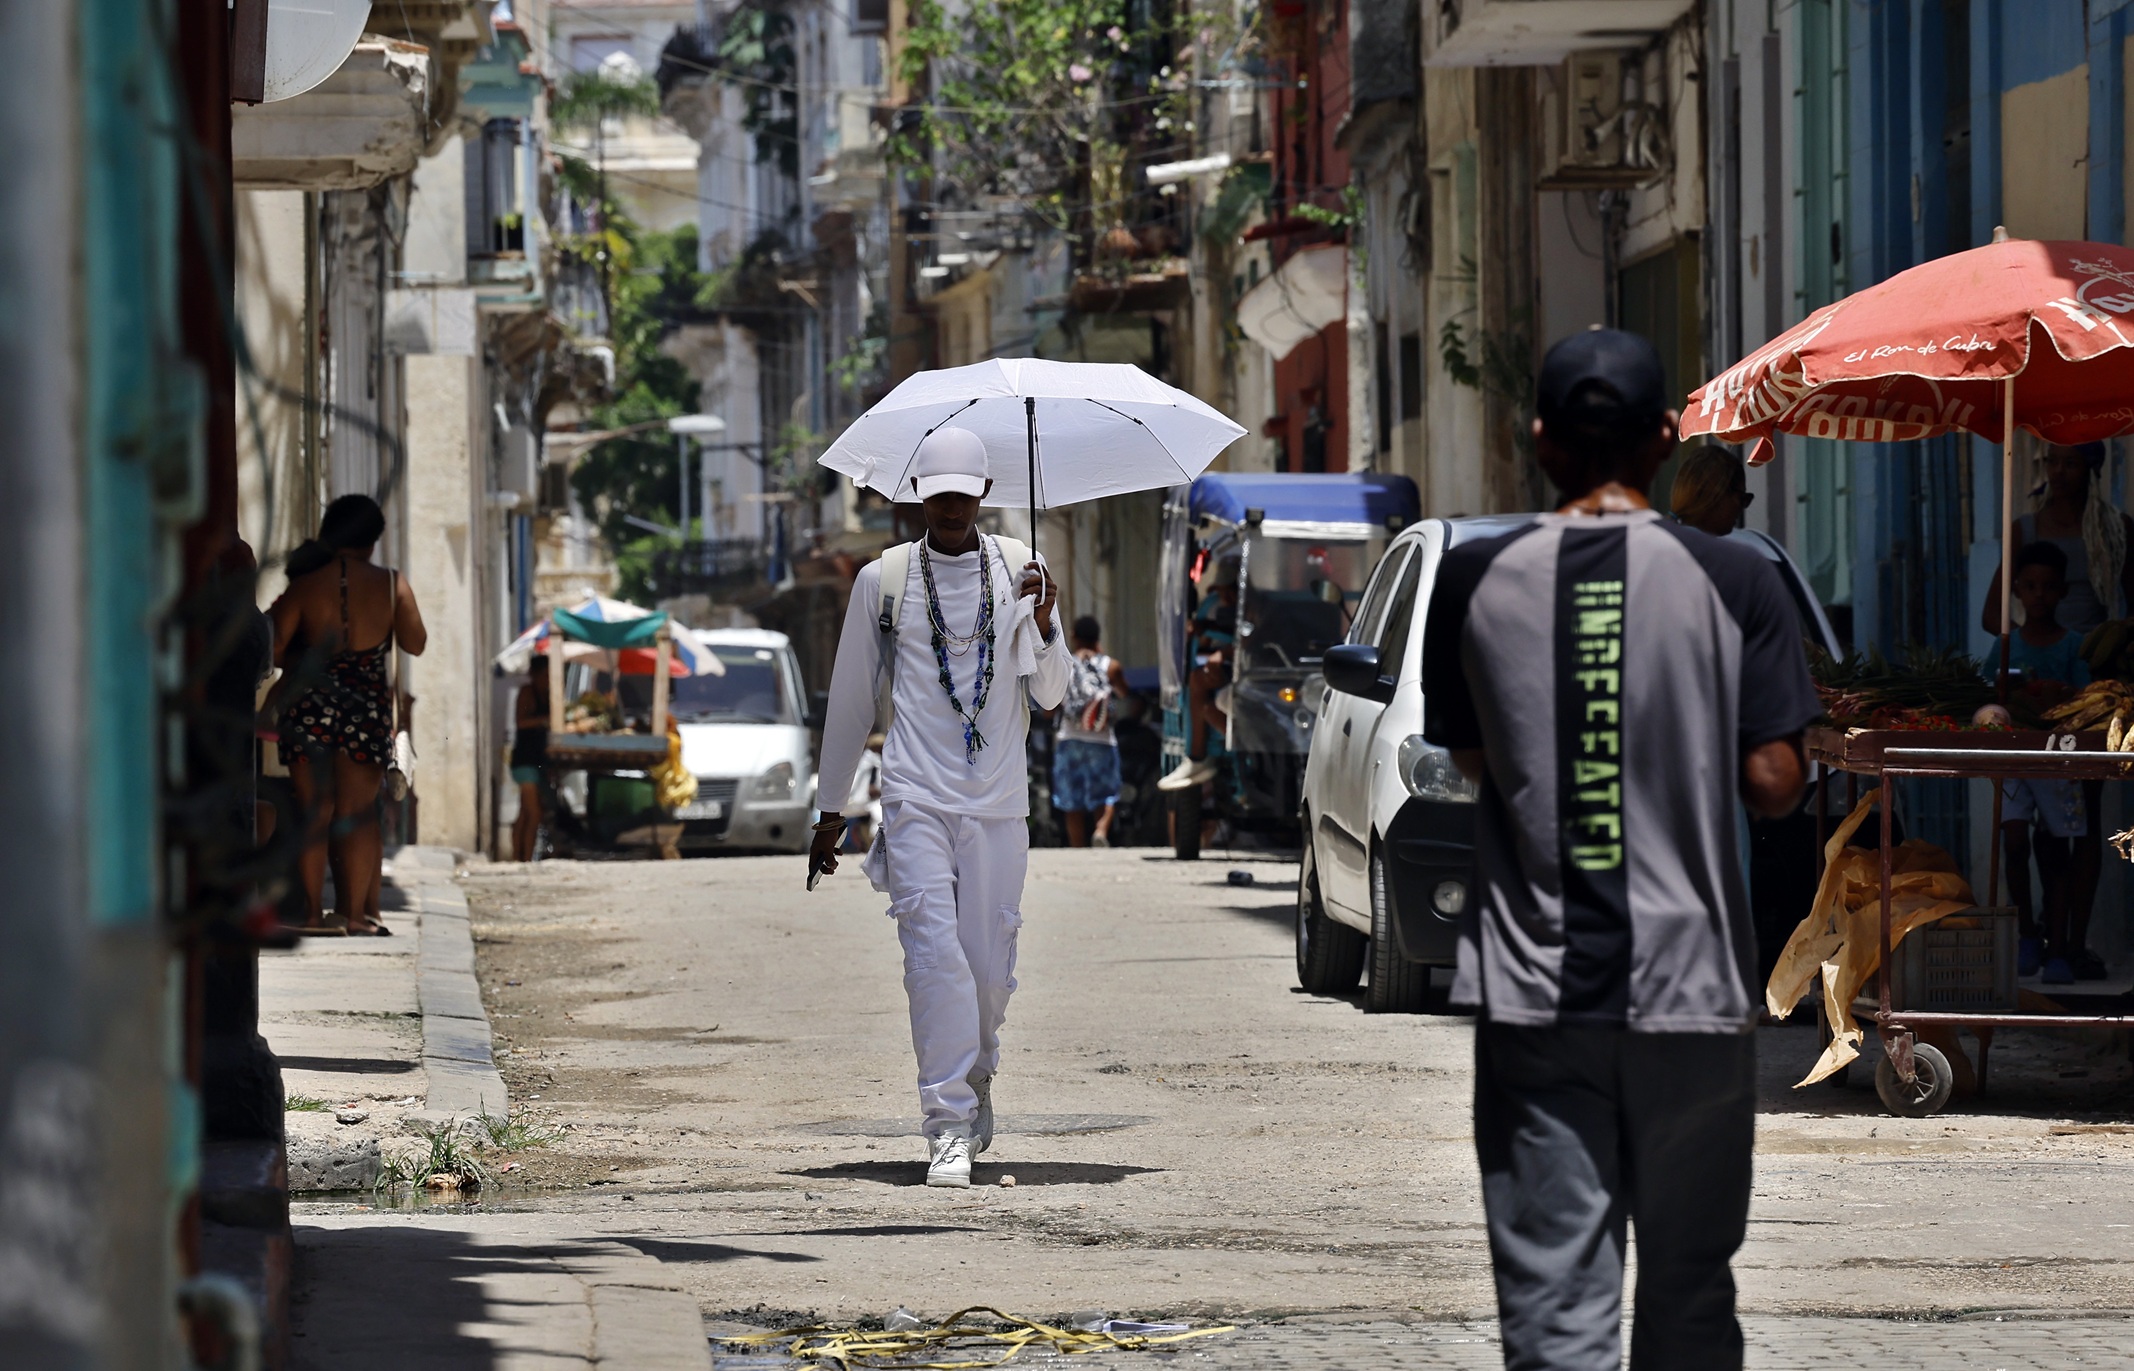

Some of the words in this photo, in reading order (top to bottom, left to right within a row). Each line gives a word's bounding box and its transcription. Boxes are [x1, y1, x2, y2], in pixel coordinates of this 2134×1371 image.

[1843, 349, 1867, 363] El
[1870, 345, 1915, 359] Ron
[1917, 340, 1937, 356] de
[1942, 333, 1997, 353] Cuba
